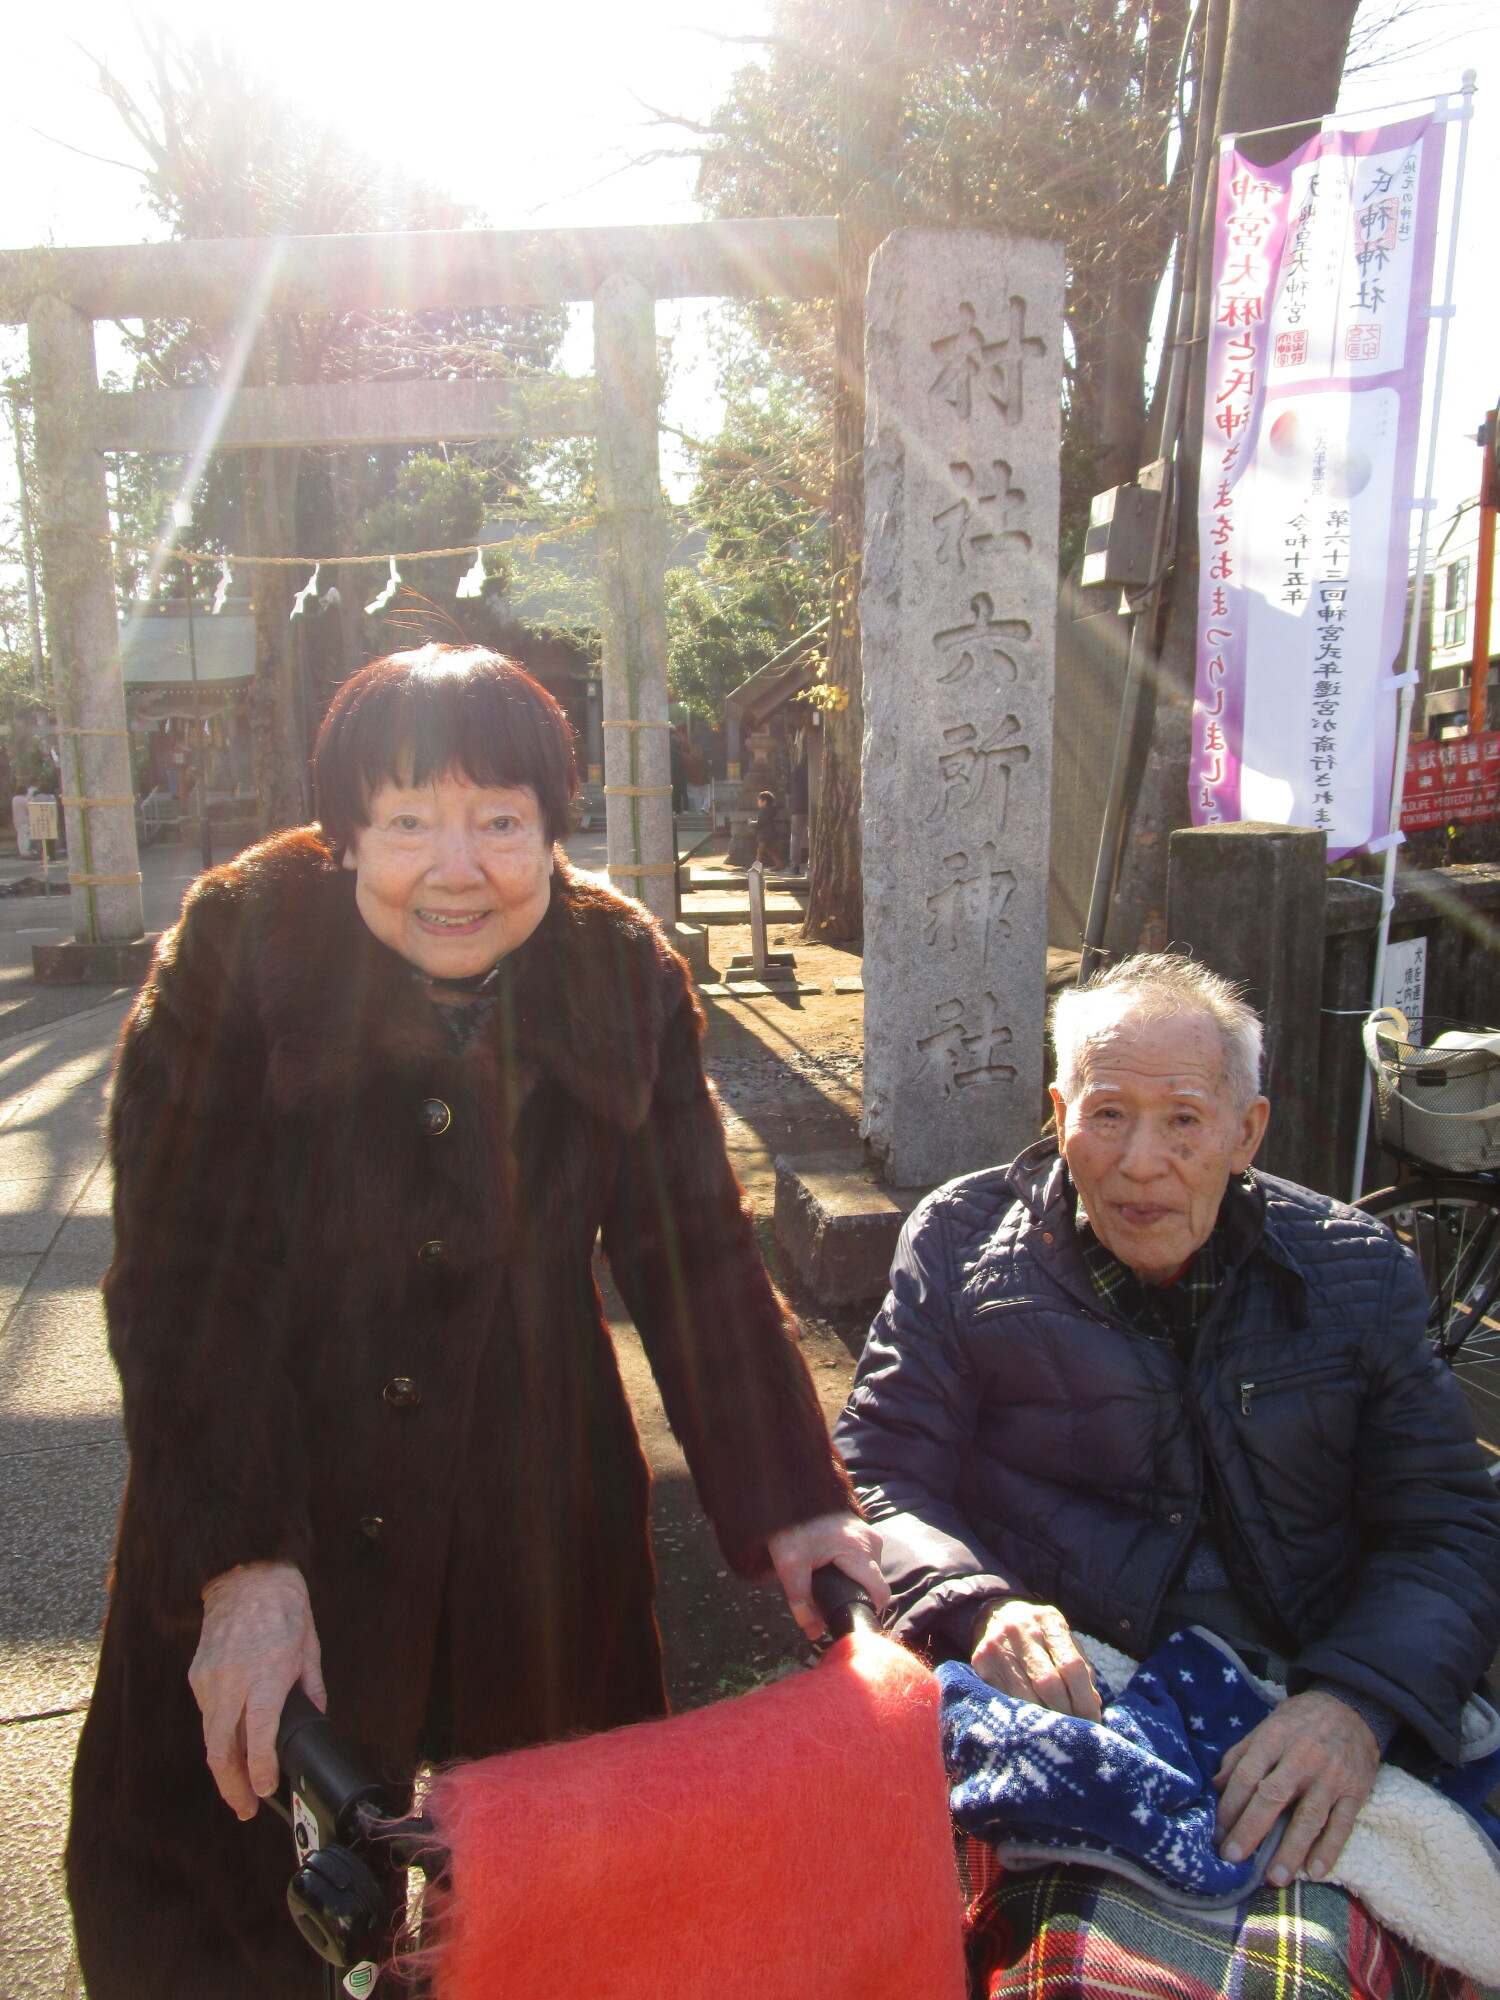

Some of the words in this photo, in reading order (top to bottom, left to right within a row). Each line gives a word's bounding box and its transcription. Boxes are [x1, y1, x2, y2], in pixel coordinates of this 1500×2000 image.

[911, 293, 1048, 1100] 村社六所神社
